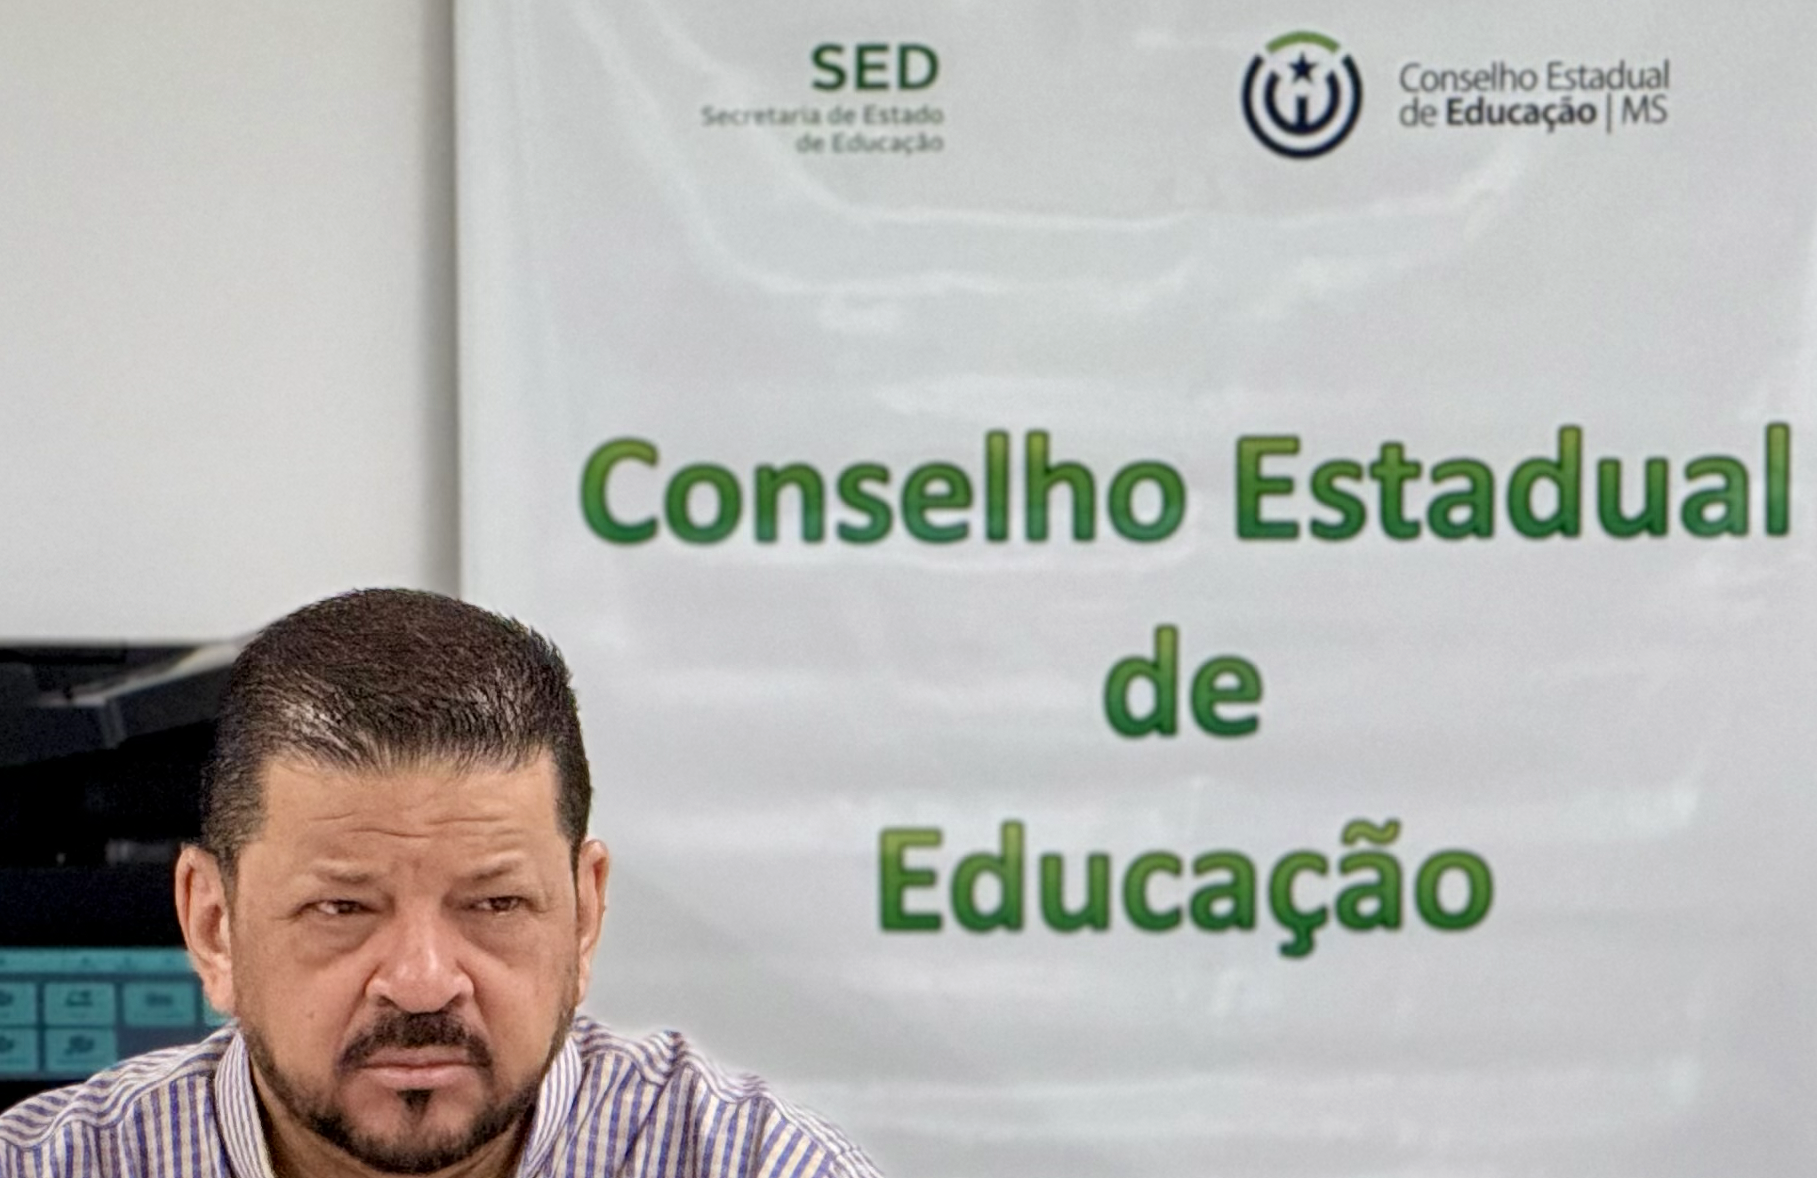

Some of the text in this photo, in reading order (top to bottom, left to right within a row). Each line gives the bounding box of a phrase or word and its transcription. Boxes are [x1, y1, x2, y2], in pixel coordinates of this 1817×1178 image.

[810, 43, 941, 92] SED
[1399, 58, 1671, 93] Conselho Estadual
[701, 103, 944, 126] Secretaria de Estado
[1399, 96, 1669, 132] de Educação MS
[795, 131, 944, 155] de Educação
[579, 421, 1793, 547] Conselho Estadual
[1102, 624, 1265, 740] de
[877, 818, 1496, 960] Educação
